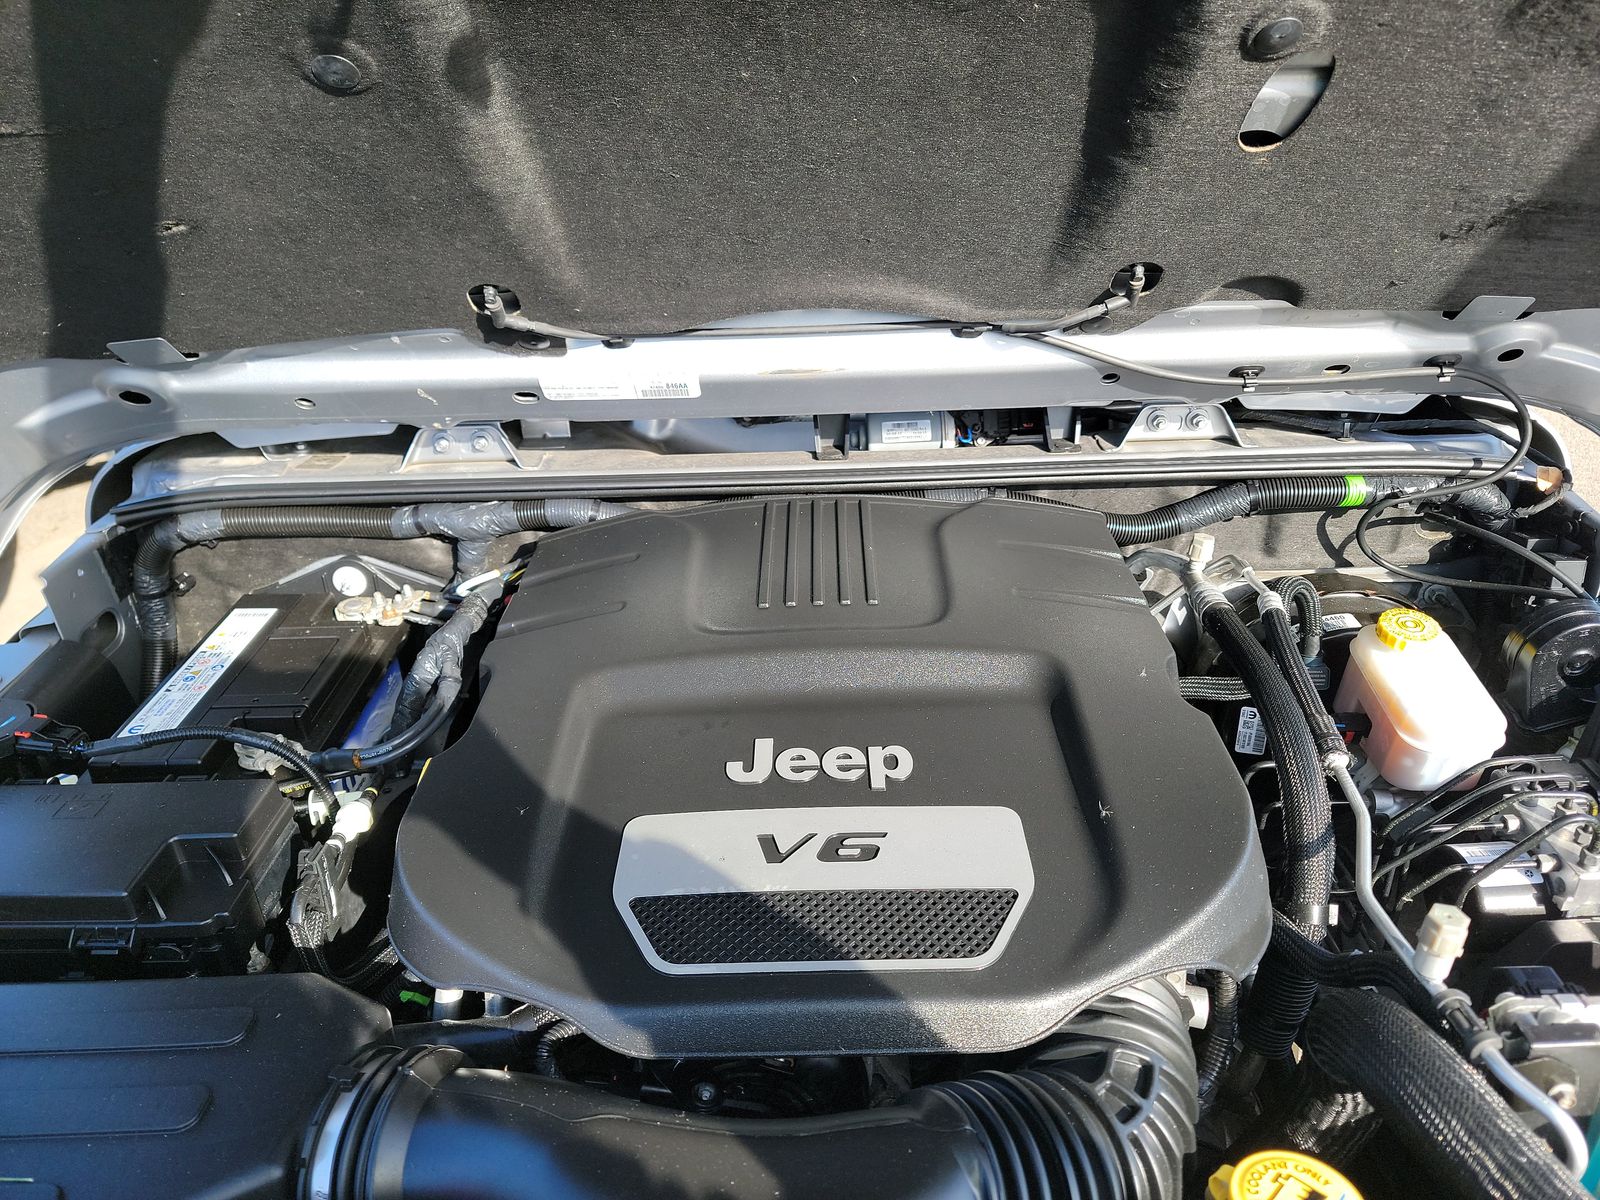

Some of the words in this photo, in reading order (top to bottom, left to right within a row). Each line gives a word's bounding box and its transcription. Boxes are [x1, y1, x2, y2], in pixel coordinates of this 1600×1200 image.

[725, 737, 914, 791] Jeep
[756, 831, 888, 864] V6
[1247, 1161, 1288, 1195] COOLANT
[1293, 1164, 1331, 1186] ONLY
